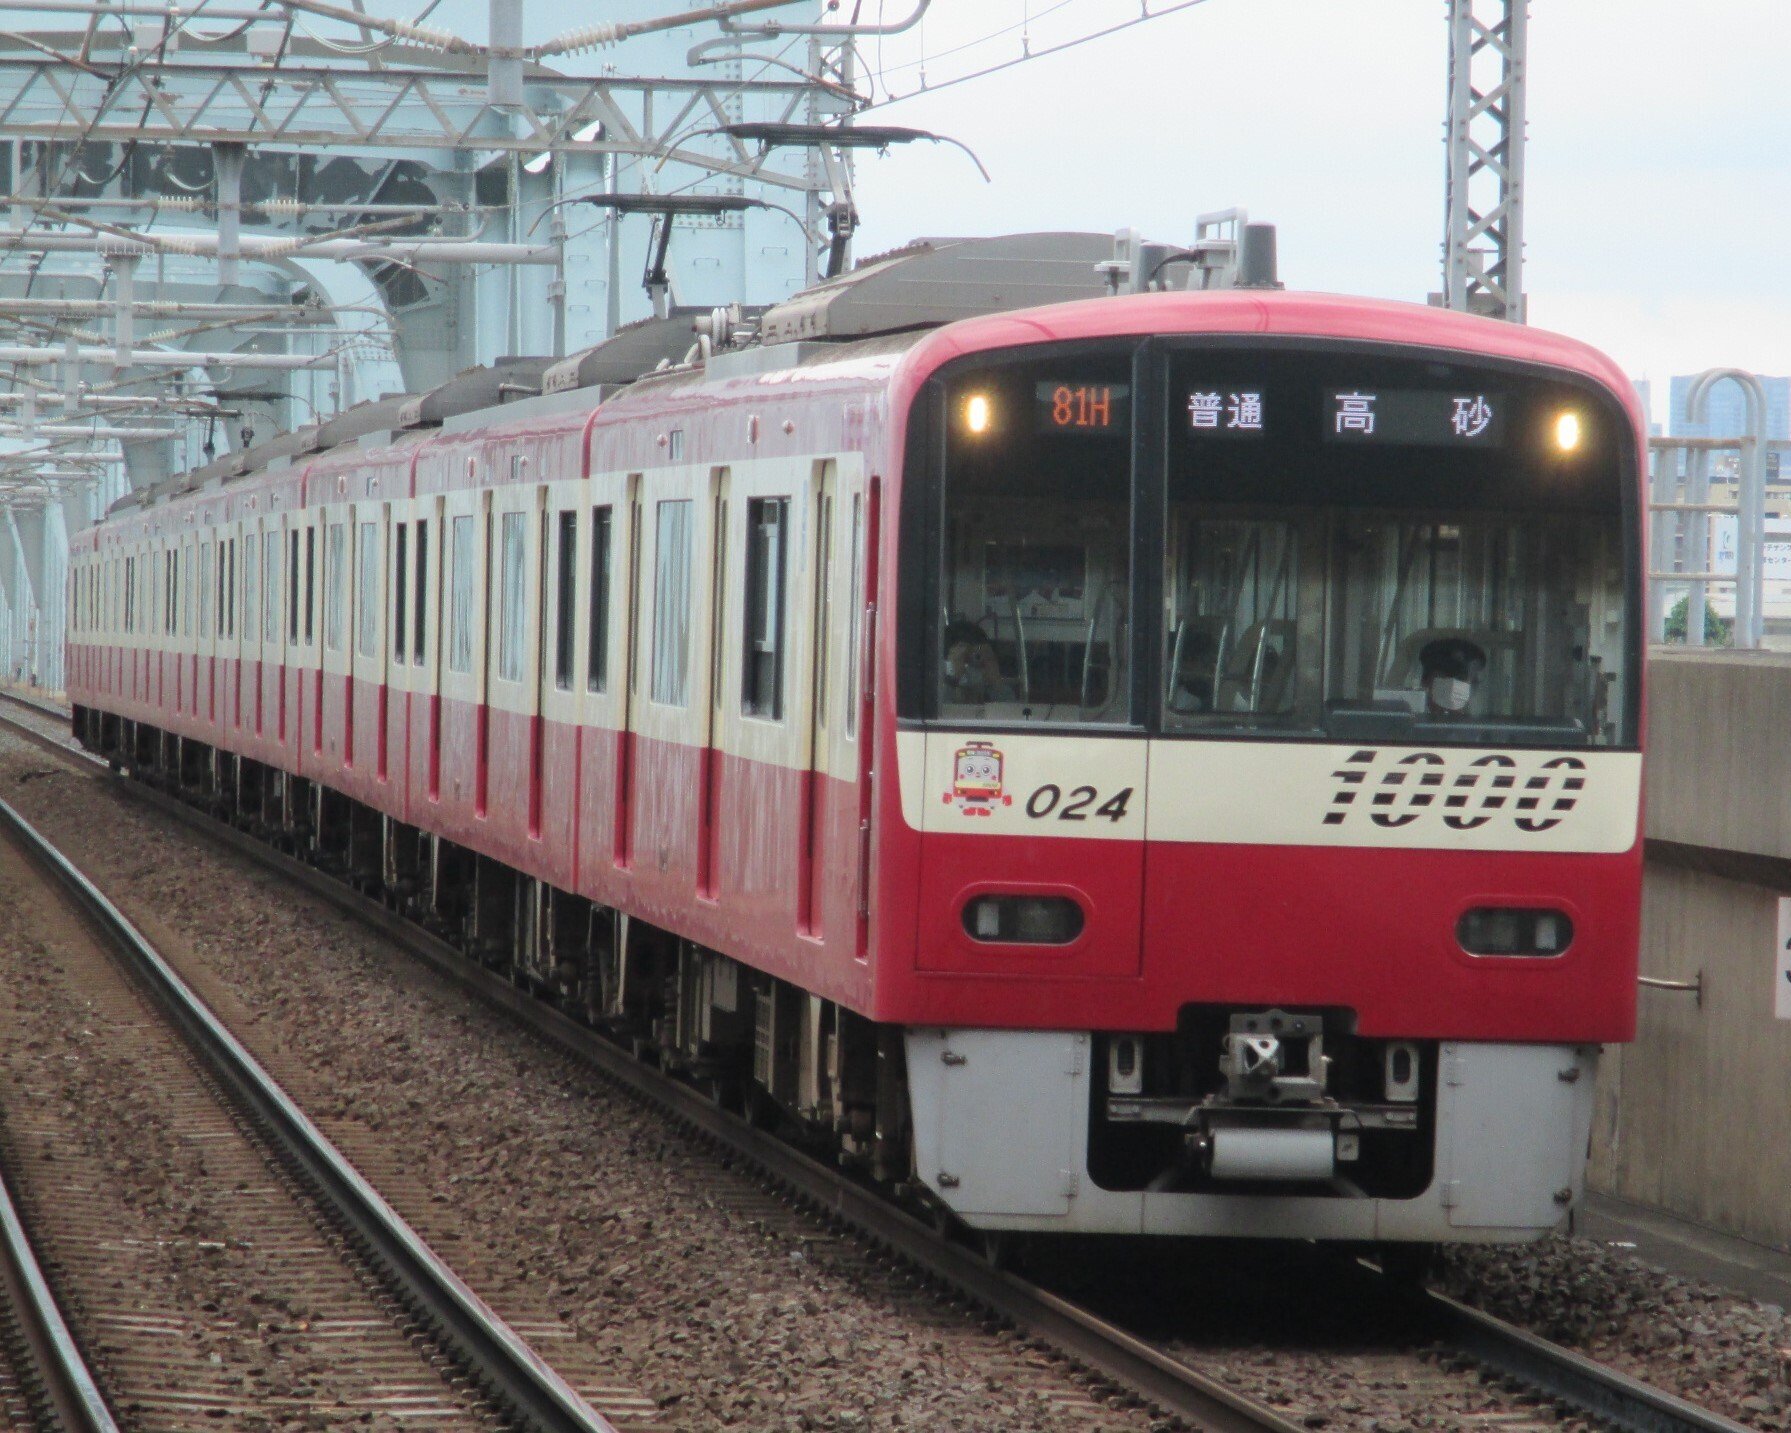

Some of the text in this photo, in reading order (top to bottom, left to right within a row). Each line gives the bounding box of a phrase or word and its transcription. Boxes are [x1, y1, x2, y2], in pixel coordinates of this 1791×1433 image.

[1053, 386, 1109, 426] 81H
[1188, 392, 1262, 428] 普通
[1026, 784, 1134, 822] 024
[1322, 750, 1586, 832] 1000
